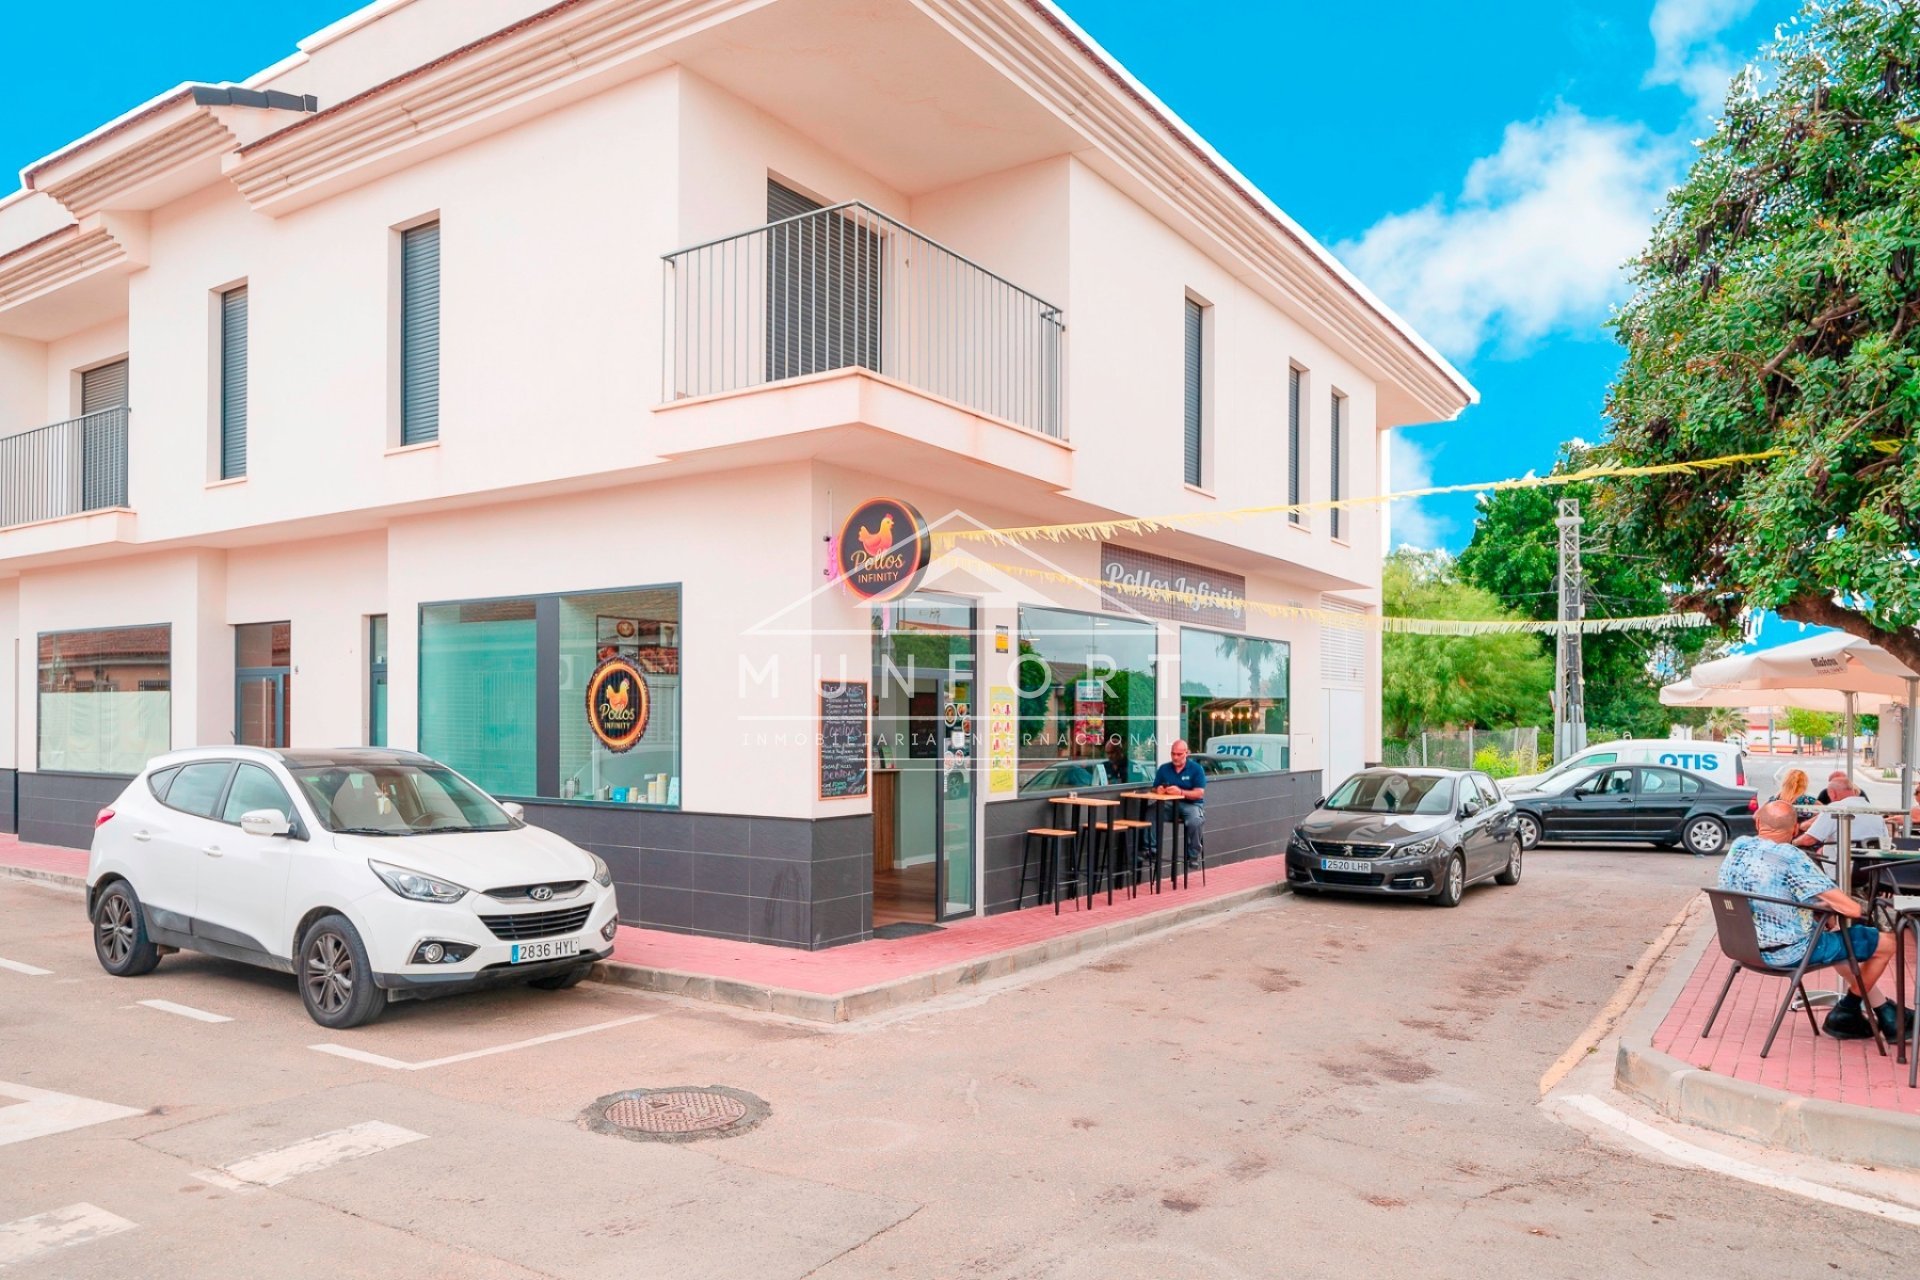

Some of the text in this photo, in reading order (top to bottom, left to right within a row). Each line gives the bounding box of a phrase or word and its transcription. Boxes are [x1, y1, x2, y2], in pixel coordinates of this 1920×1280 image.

[850, 547, 905, 572] Pollos
[858, 571, 899, 583] INFINITY
[1105, 562, 1171, 597] Pollos
[599, 703, 635, 720] Pollos
[1659, 753, 1719, 771] OTIS
[1328, 860, 1370, 872] 2520 LHR
[520, 940, 577, 960] 2836 HYL
